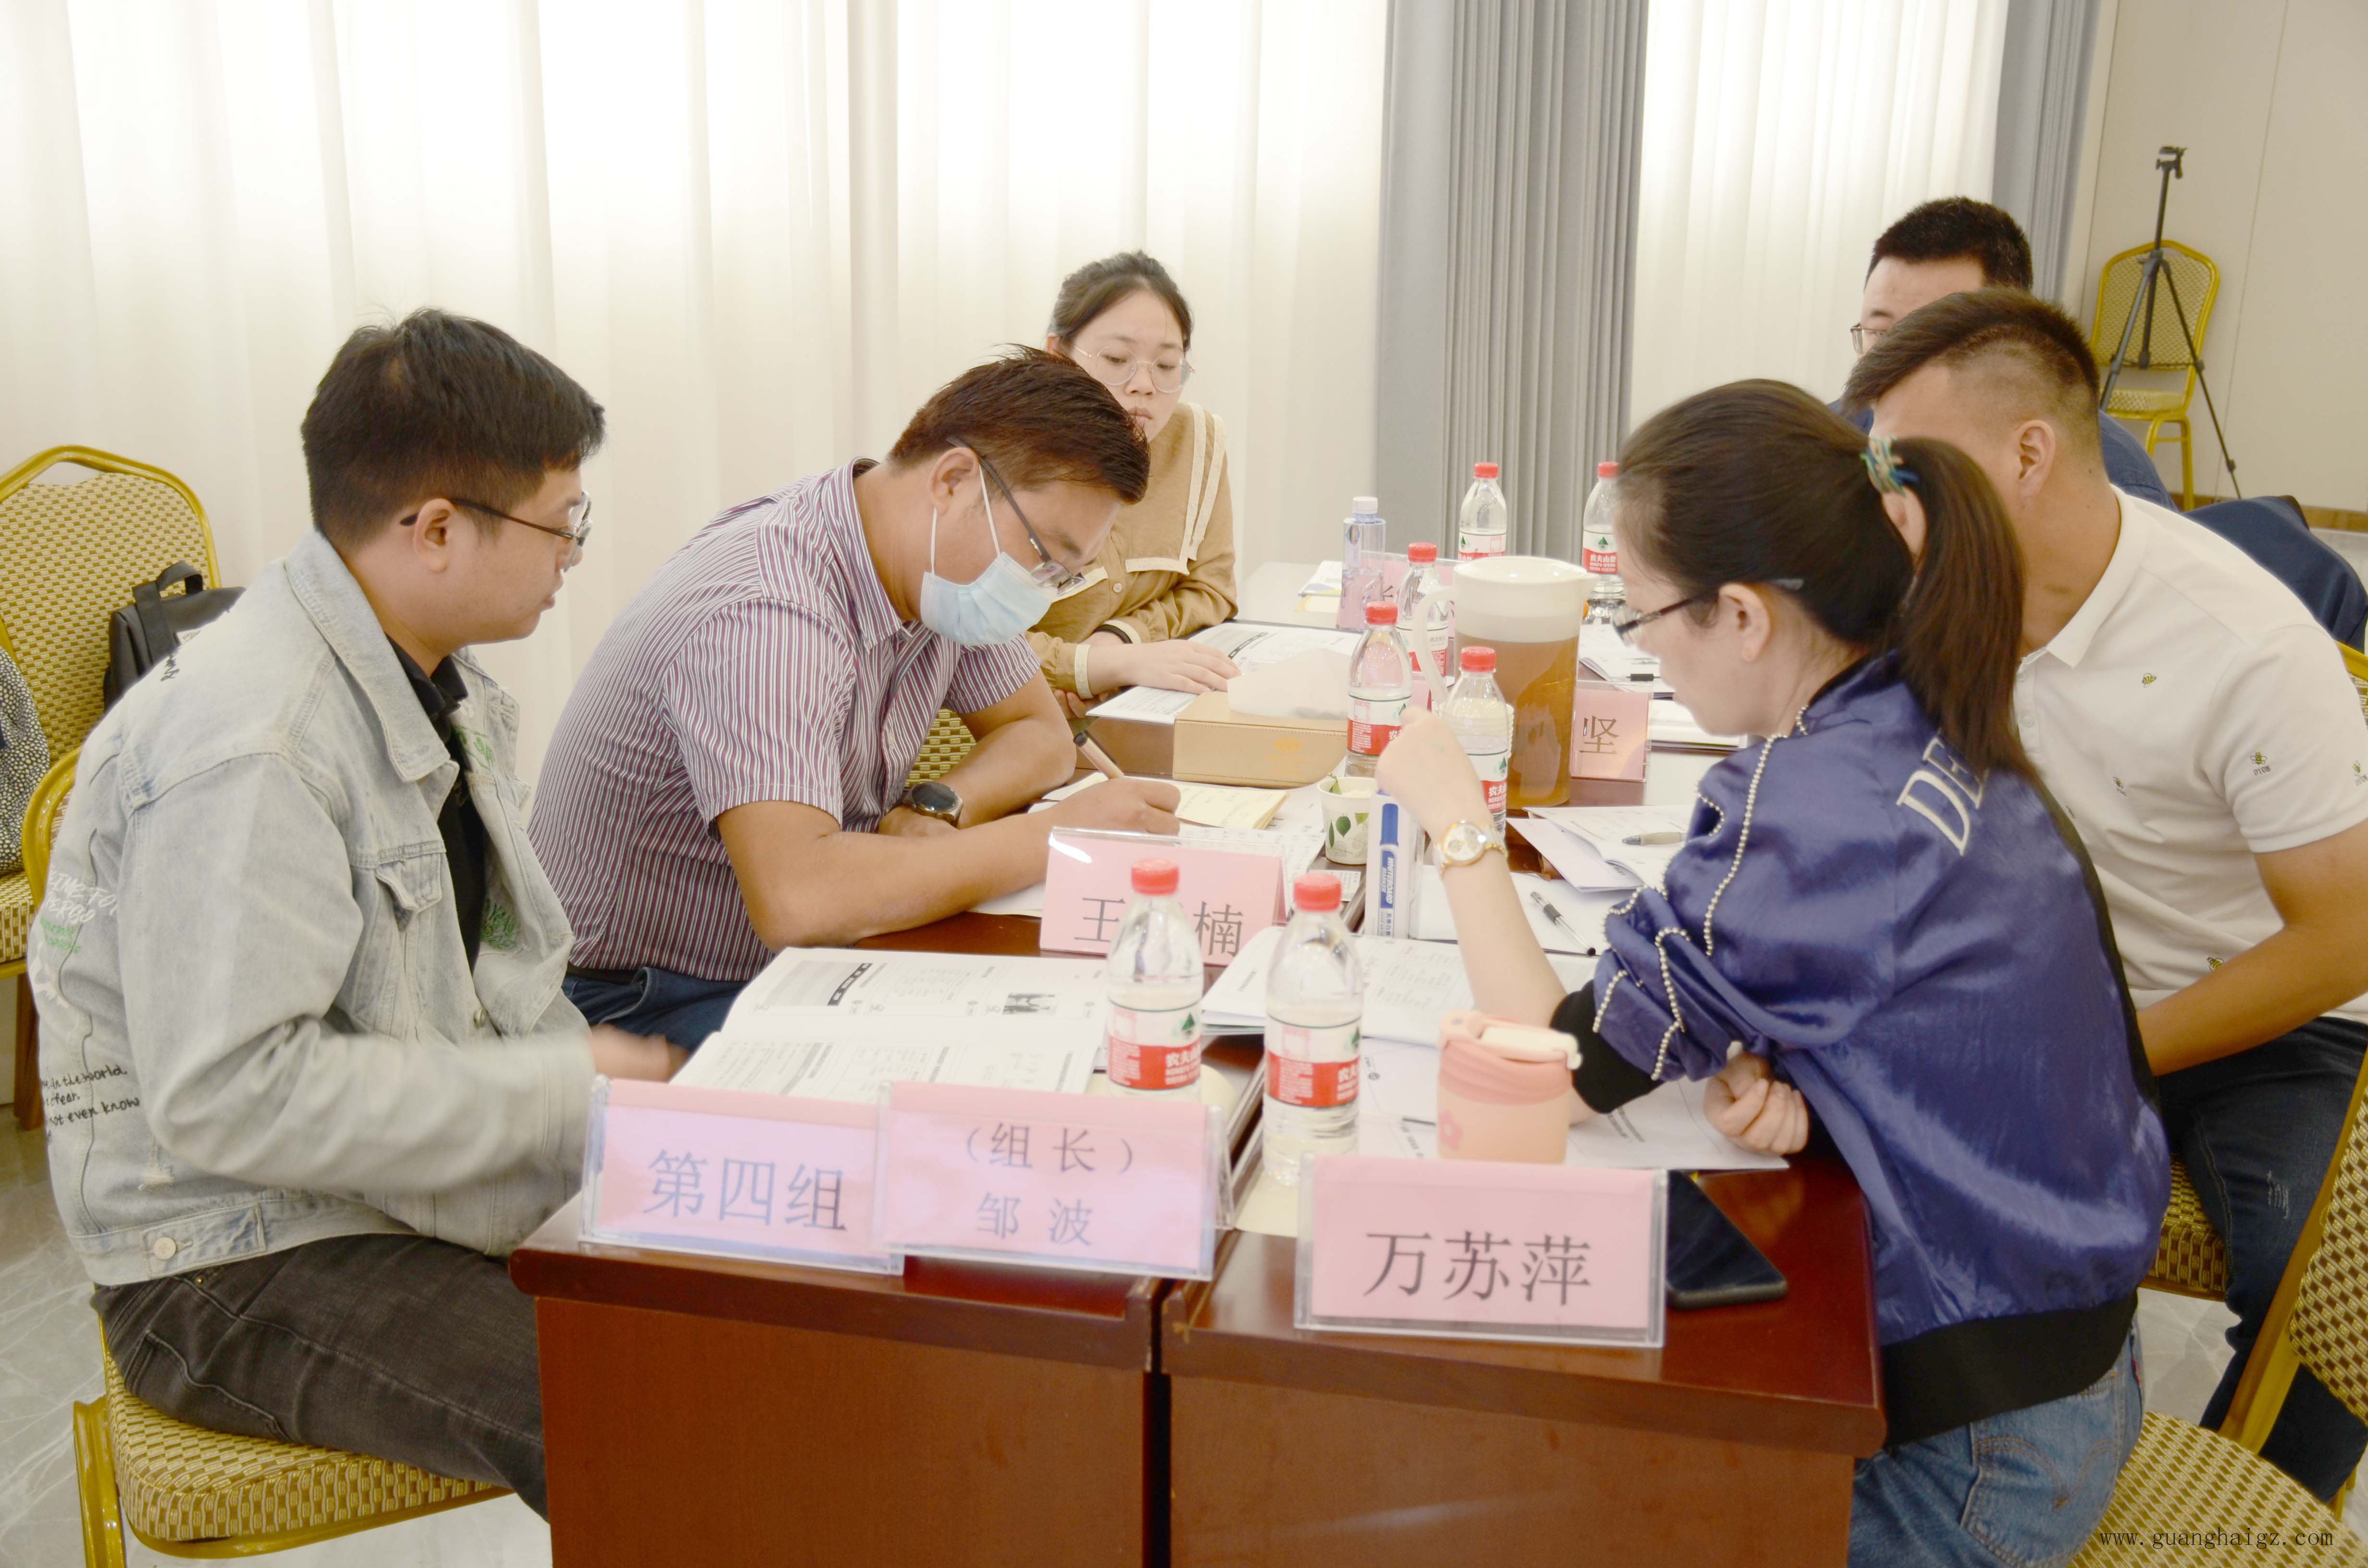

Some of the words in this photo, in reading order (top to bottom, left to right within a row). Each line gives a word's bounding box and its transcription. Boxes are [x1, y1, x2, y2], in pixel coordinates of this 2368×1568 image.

[1074, 897, 1244, 957] 王楠
[68, 1106, 99, 1123] even
[101, 1097, 141, 1115] know
[643, 1149, 847, 1231] 第四组
[1363, 1230, 1591, 1306] 万苏萍
